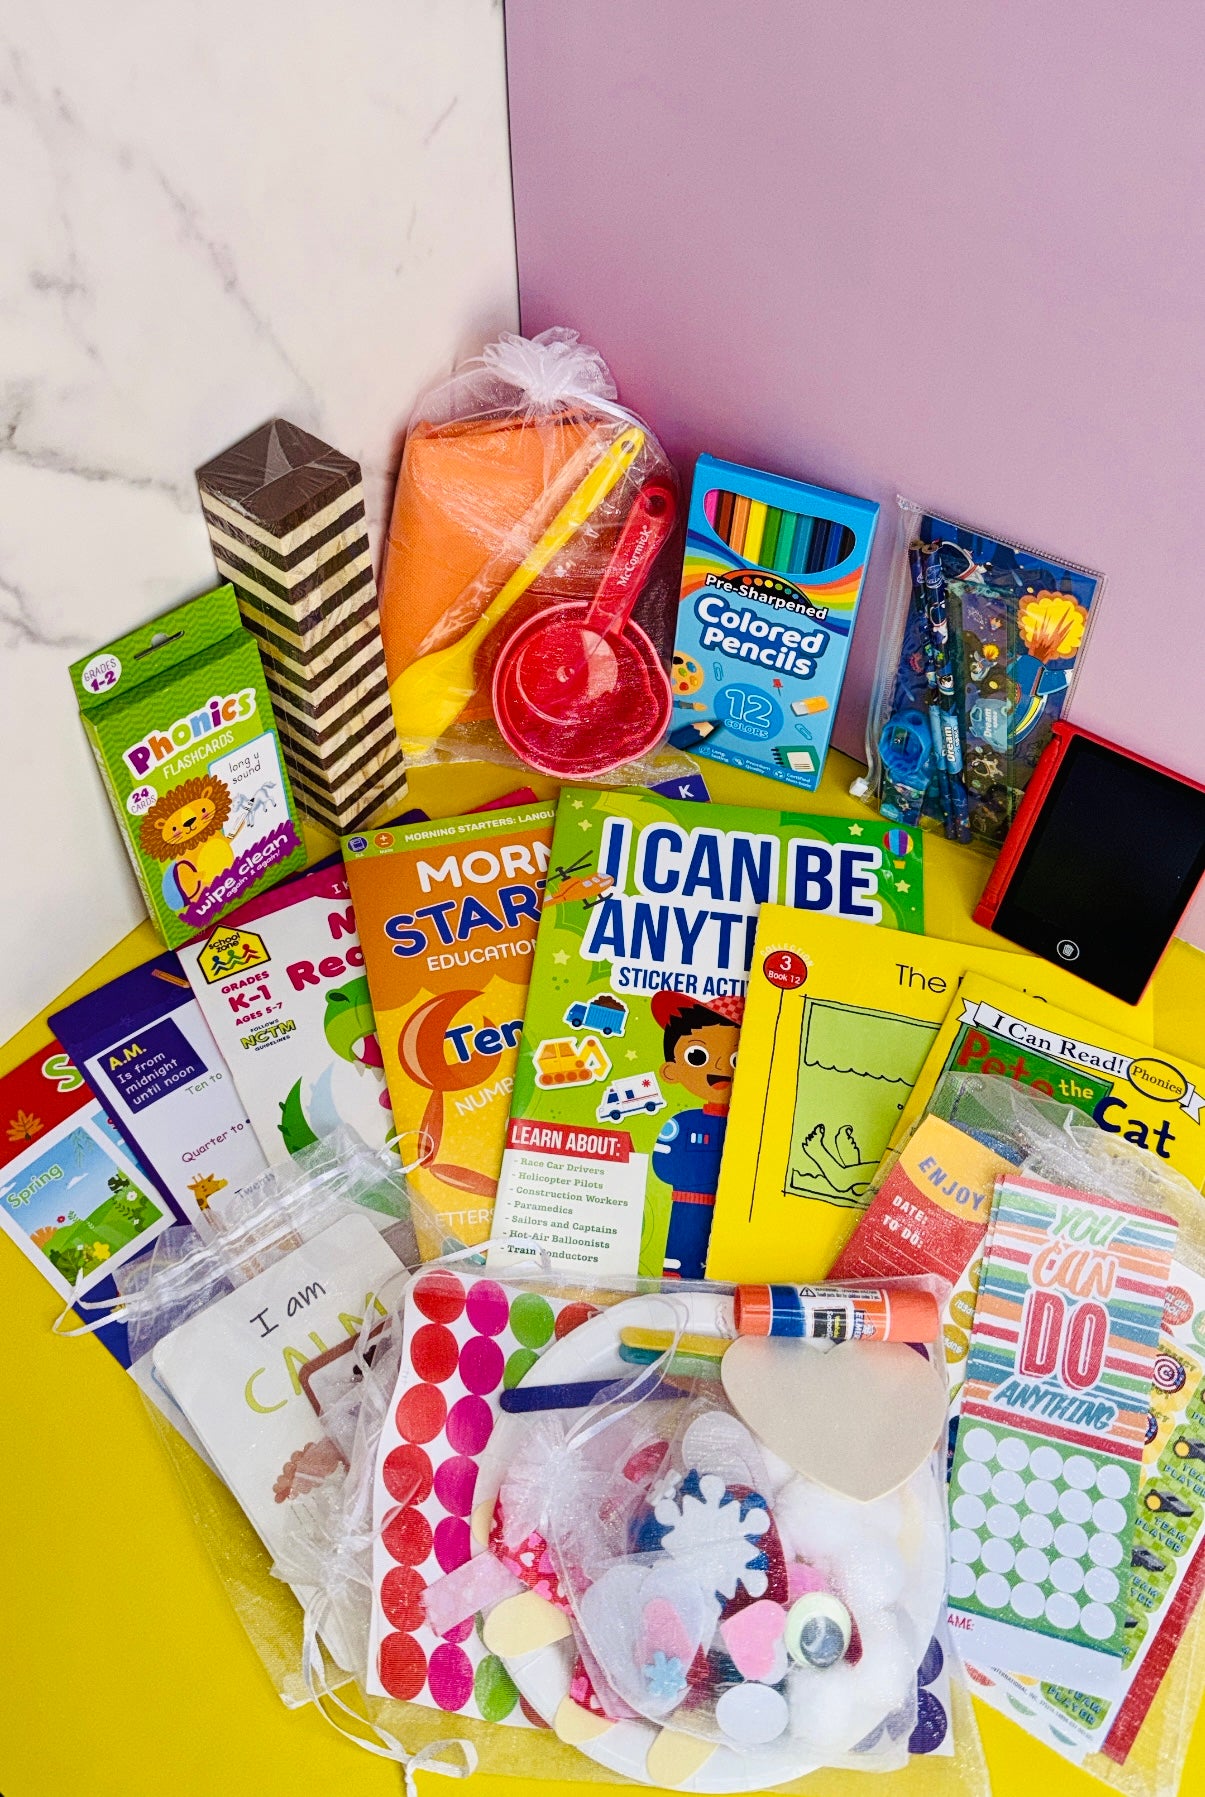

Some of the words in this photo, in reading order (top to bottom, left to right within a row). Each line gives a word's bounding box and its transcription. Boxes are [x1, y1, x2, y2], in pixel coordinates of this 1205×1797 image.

[705, 574, 828, 620] Pre-Sharpened
[698, 597, 824, 654] Colored
[704, 627, 811, 675] Pencils
[84, 658, 116, 681] GRADES
[91, 670, 116, 691] 1-2
[725, 689, 773, 728] 12
[126, 692, 252, 776] Phonics
[724, 719, 769, 739] COLORS
[163, 730, 234, 779] FLASHCARDS
[229, 757, 252, 773] long
[232, 761, 261, 784] sound
[131, 795, 156, 813] CARDS
[132, 787, 149, 803] 24
[678, 784, 694, 800] K
[405, 822, 456, 843] MORNING
[458, 817, 517, 834] STARTERS:
[196, 877, 236, 915] wipe
[238, 834, 288, 875] clean
[226, 876, 248, 898] again
[256, 849, 280, 871] again!
[604, 822, 625, 887] I
[642, 828, 773, 904] CAN
[793, 844, 875, 917] BE
[208, 932, 240, 950] school
[216, 941, 239, 953] zone
[768, 970, 788, 982] Book
[790, 975, 801, 985] 12
[780, 955, 792, 971] 3
[221, 970, 269, 994] GRADES
[618, 966, 698, 994] STICKER
[895, 963, 947, 994] The
[228, 984, 272, 1013] K-1
[236, 1010, 263, 1026] AGES
[266, 1002, 283, 1014] 5-7
[250, 1019, 279, 1033] FOLLOWS
[240, 1019, 297, 1050] NCTM
[992, 1013, 1003, 1030] I
[1008, 1023, 1052, 1051] Can
[1058, 1039, 1124, 1074] Read!
[109, 1043, 147, 1071] A.M.
[117, 1072, 133, 1084] Is
[134, 1052, 166, 1073] from
[956, 1027, 1054, 1098] Pete
[125, 1058, 178, 1095] midnight
[132, 1083, 161, 1105] until
[164, 1065, 195, 1087] noon
[185, 1081, 209, 1095] Ten
[209, 1072, 223, 1082] to
[1058, 1079, 1094, 1099] the
[1132, 1065, 1183, 1095] Phonics
[455, 1074, 515, 1116] NUMB
[511, 1125, 563, 1149] LEARN
[565, 1132, 621, 1157] ABOUT:
[1092, 1096, 1176, 1159] Cat
[181, 1131, 228, 1163] Quarter
[230, 1123, 244, 1134] to
[518, 1171, 572, 1186] Helicopter
[574, 1178, 603, 1190] Pilots
[520, 1158, 544, 1168] Race
[546, 1161, 564, 1171] Car
[566, 1164, 605, 1176] Drivers
[7, 1164, 64, 1210] Spring
[516, 1186, 583, 1202] Construction
[585, 1194, 629, 1207] Workers
[918, 1156, 985, 1211] ENJOY
[513, 1201, 573, 1215] Paramedics
[892, 1195, 928, 1225] DATE:
[511, 1215, 549, 1227] Sailors
[550, 1219, 570, 1229] and
[572, 1223, 618, 1235] Captains
[883, 1215, 900, 1231] TO
[901, 1228, 924, 1248] DO:
[1051, 1203, 1129, 1246] YOU
[507, 1245, 536, 1256] Train
[509, 1230, 550, 1242] Hot-Air
[552, 1235, 610, 1249] Balloonists
[1033, 1243, 1116, 1298] CAN
[249, 1307, 279, 1338] I
[287, 1281, 326, 1317] am
[1019, 1290, 1109, 1391] DO
[993, 1379, 1116, 1430] ANYTHING
[1182, 1463, 1205, 1483] TEA
[1154, 1516, 1187, 1543] TEAM
